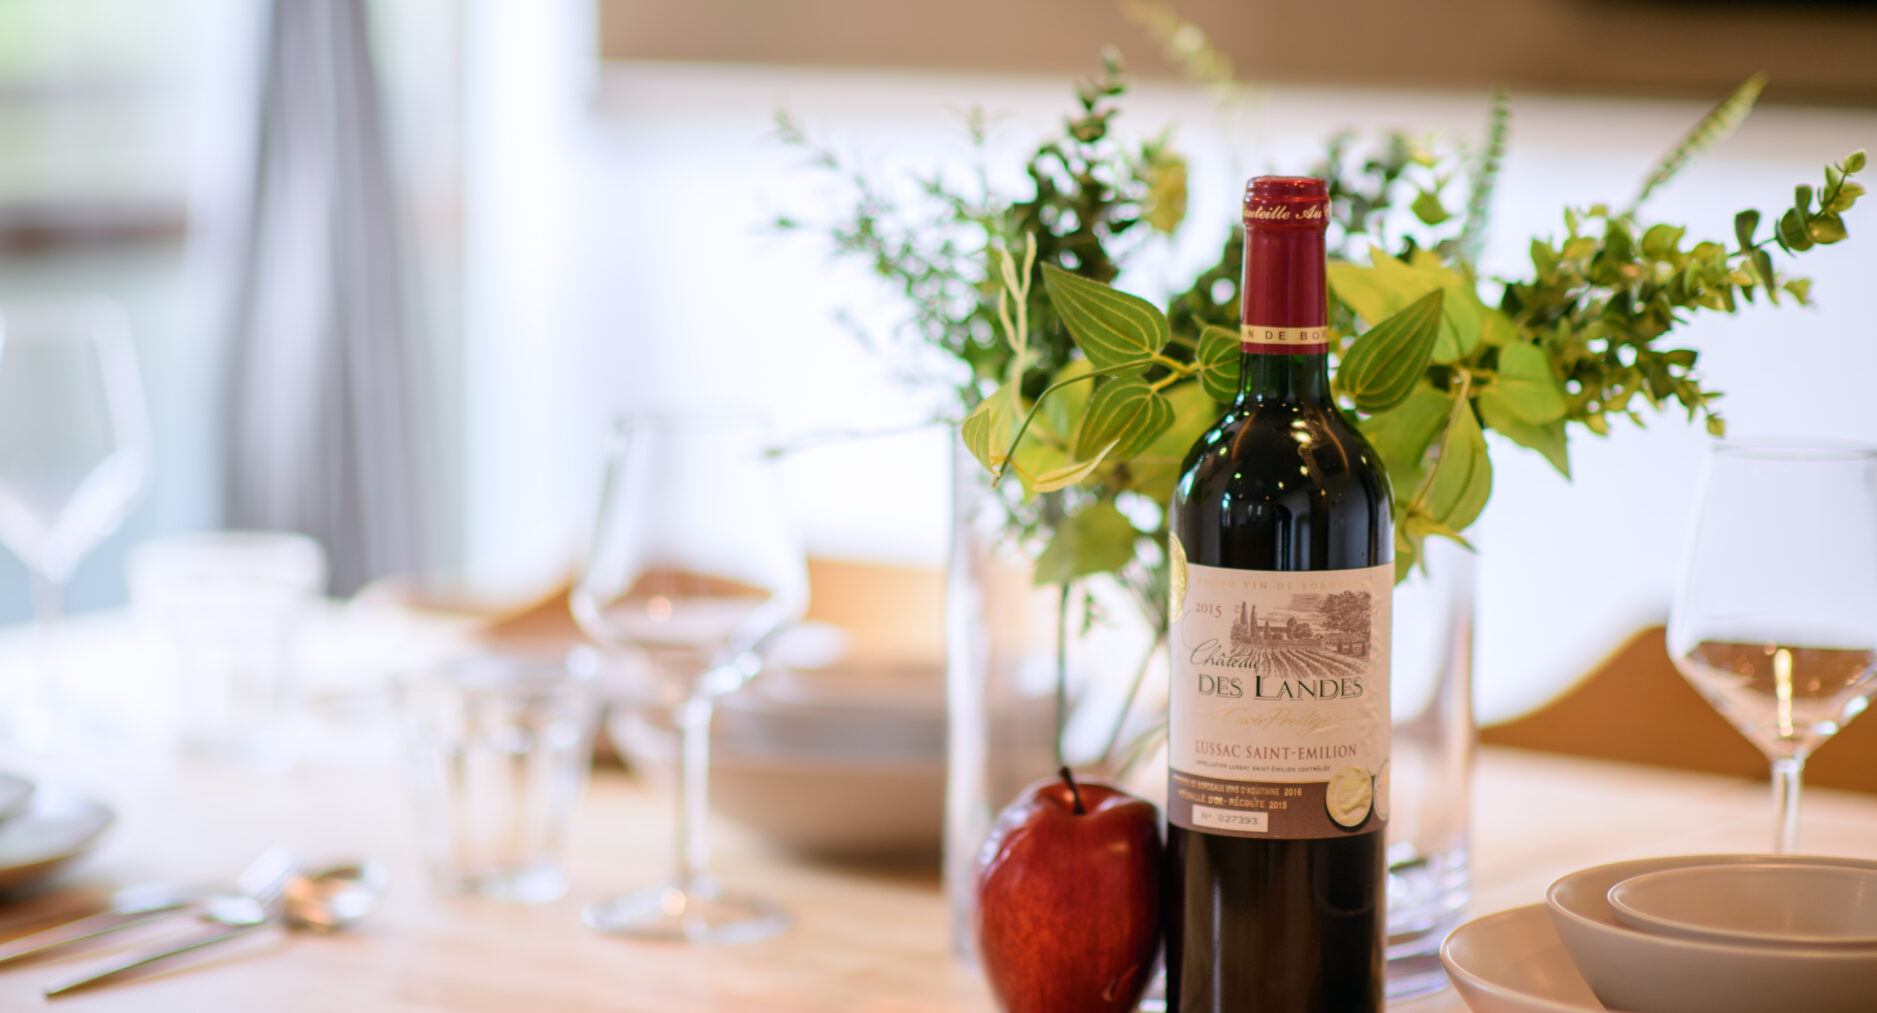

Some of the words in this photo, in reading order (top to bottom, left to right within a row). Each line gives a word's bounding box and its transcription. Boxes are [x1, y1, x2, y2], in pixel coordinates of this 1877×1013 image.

[1265, 331, 1287, 340] DE
[1242, 581, 1268, 591] VIN
[1276, 582, 1293, 591] DE
[1195, 602, 1222, 618] 2015
[1190, 638, 1257, 669] Château
[1198, 674, 1243, 698] DES
[1254, 675, 1363, 701] LANDES
[1195, 740, 1242, 758] LUSSAC
[1246, 744, 1357, 760] SAINT-EMILION
[1283, 787, 1303, 797] 2016
[1268, 801, 1288, 810] 2015
[1218, 814, 1258, 826] 027393
